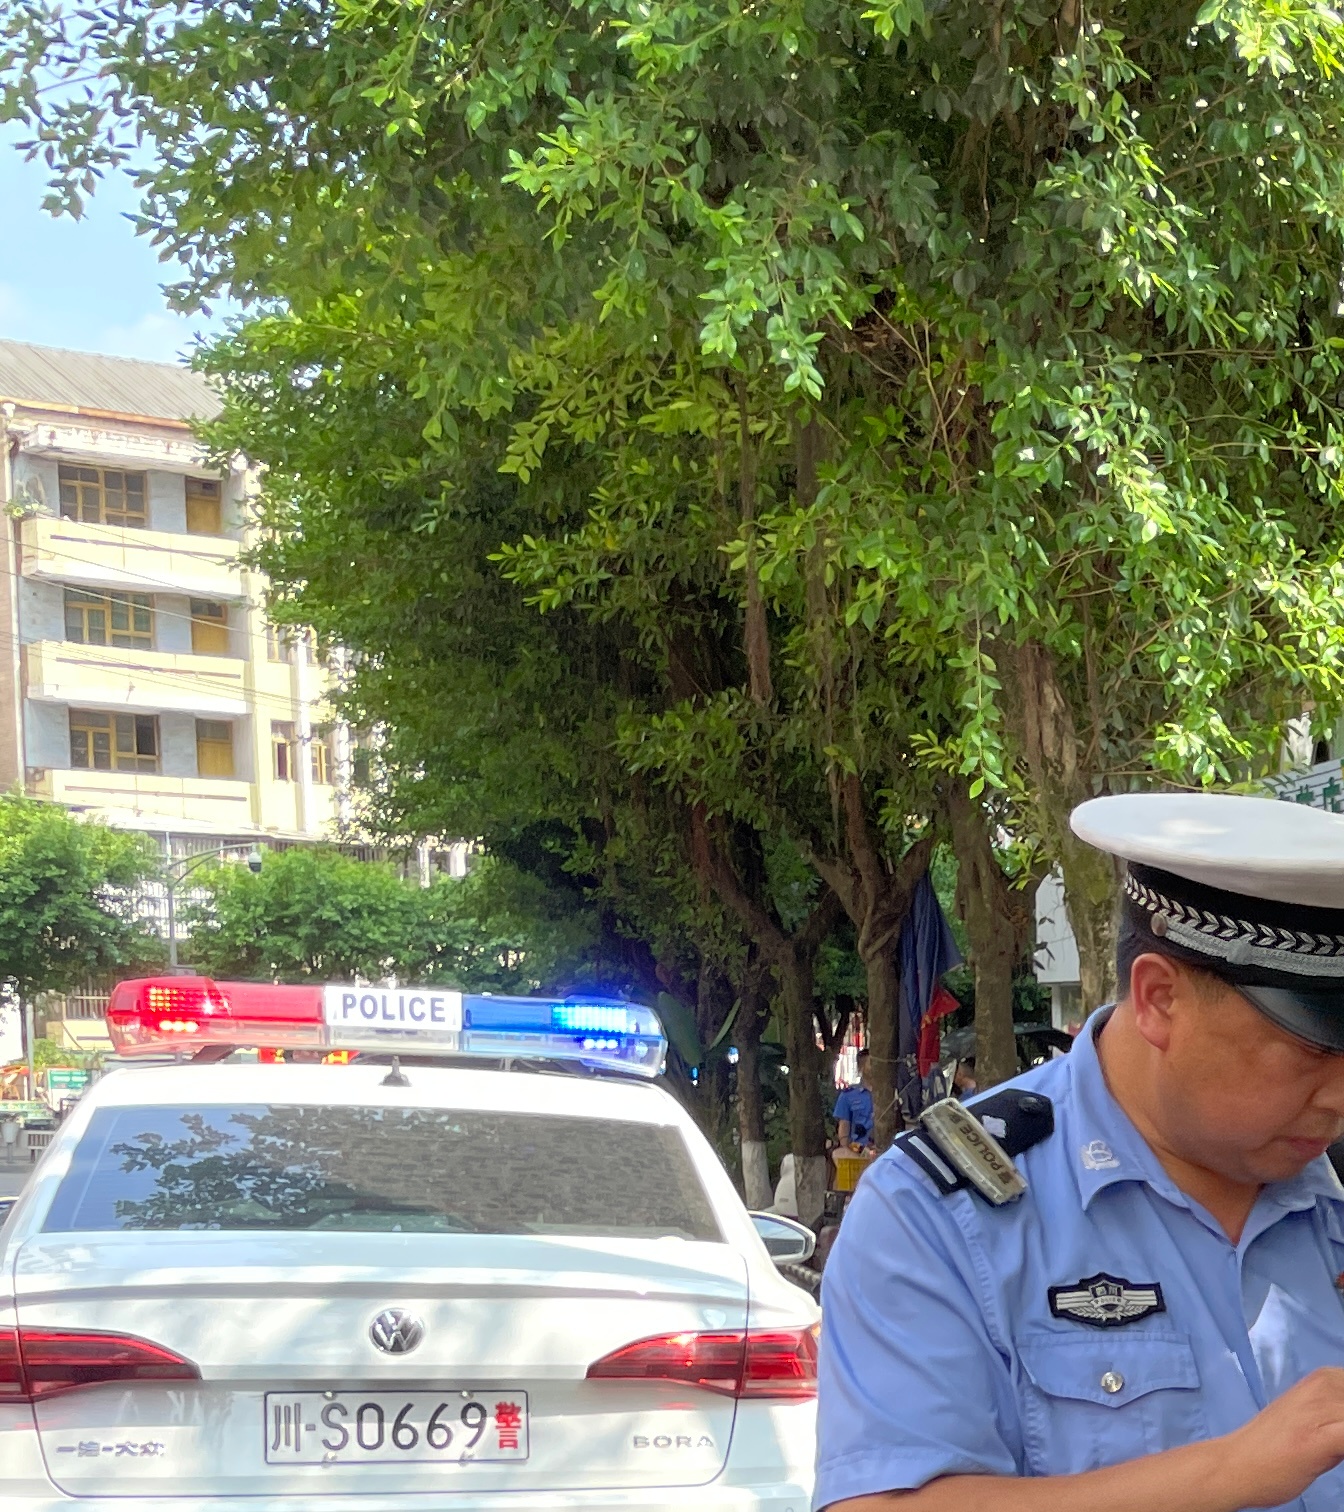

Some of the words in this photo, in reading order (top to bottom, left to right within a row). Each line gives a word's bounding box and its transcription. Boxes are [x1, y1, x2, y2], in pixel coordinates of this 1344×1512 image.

[342, 993, 446, 1022] POLICE
[959, 1123, 1004, 1172] POLICE
[633, 1435, 715, 1448] BORA
